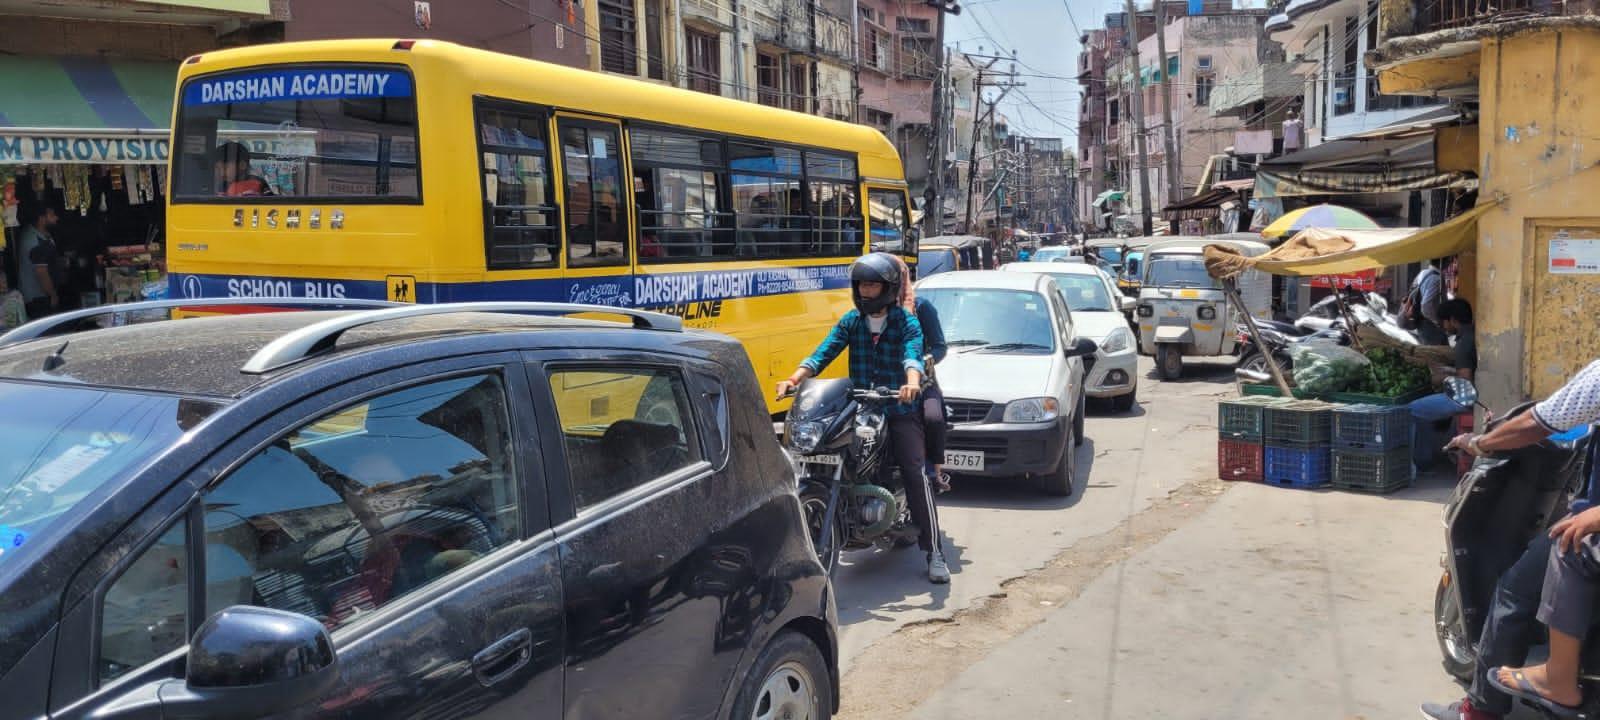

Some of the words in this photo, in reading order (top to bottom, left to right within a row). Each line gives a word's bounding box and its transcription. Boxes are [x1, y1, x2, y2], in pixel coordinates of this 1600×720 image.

[201, 77, 284, 103] DARSHAN
[290, 73, 390, 96] ACADEMY
[227, 278, 292, 299] SCHOOL
[701, 272, 754, 299] ACADEMY
[943, 453, 982, 468] F6767
